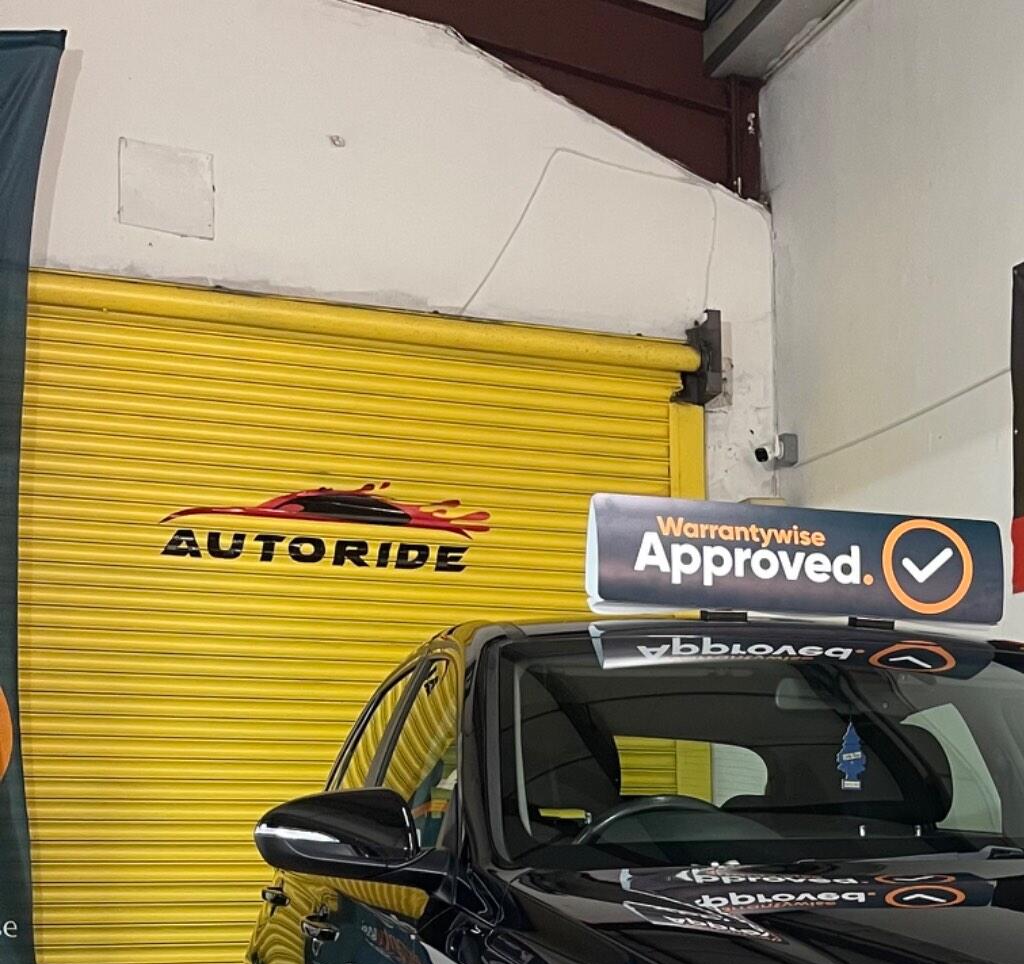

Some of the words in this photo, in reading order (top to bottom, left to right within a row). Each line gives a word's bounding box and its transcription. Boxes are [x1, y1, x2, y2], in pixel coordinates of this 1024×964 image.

[160, 528, 470, 572] AUTORIDE
[656, 515, 826, 547] Warrantywise
[633, 532, 874, 586] Approved.
